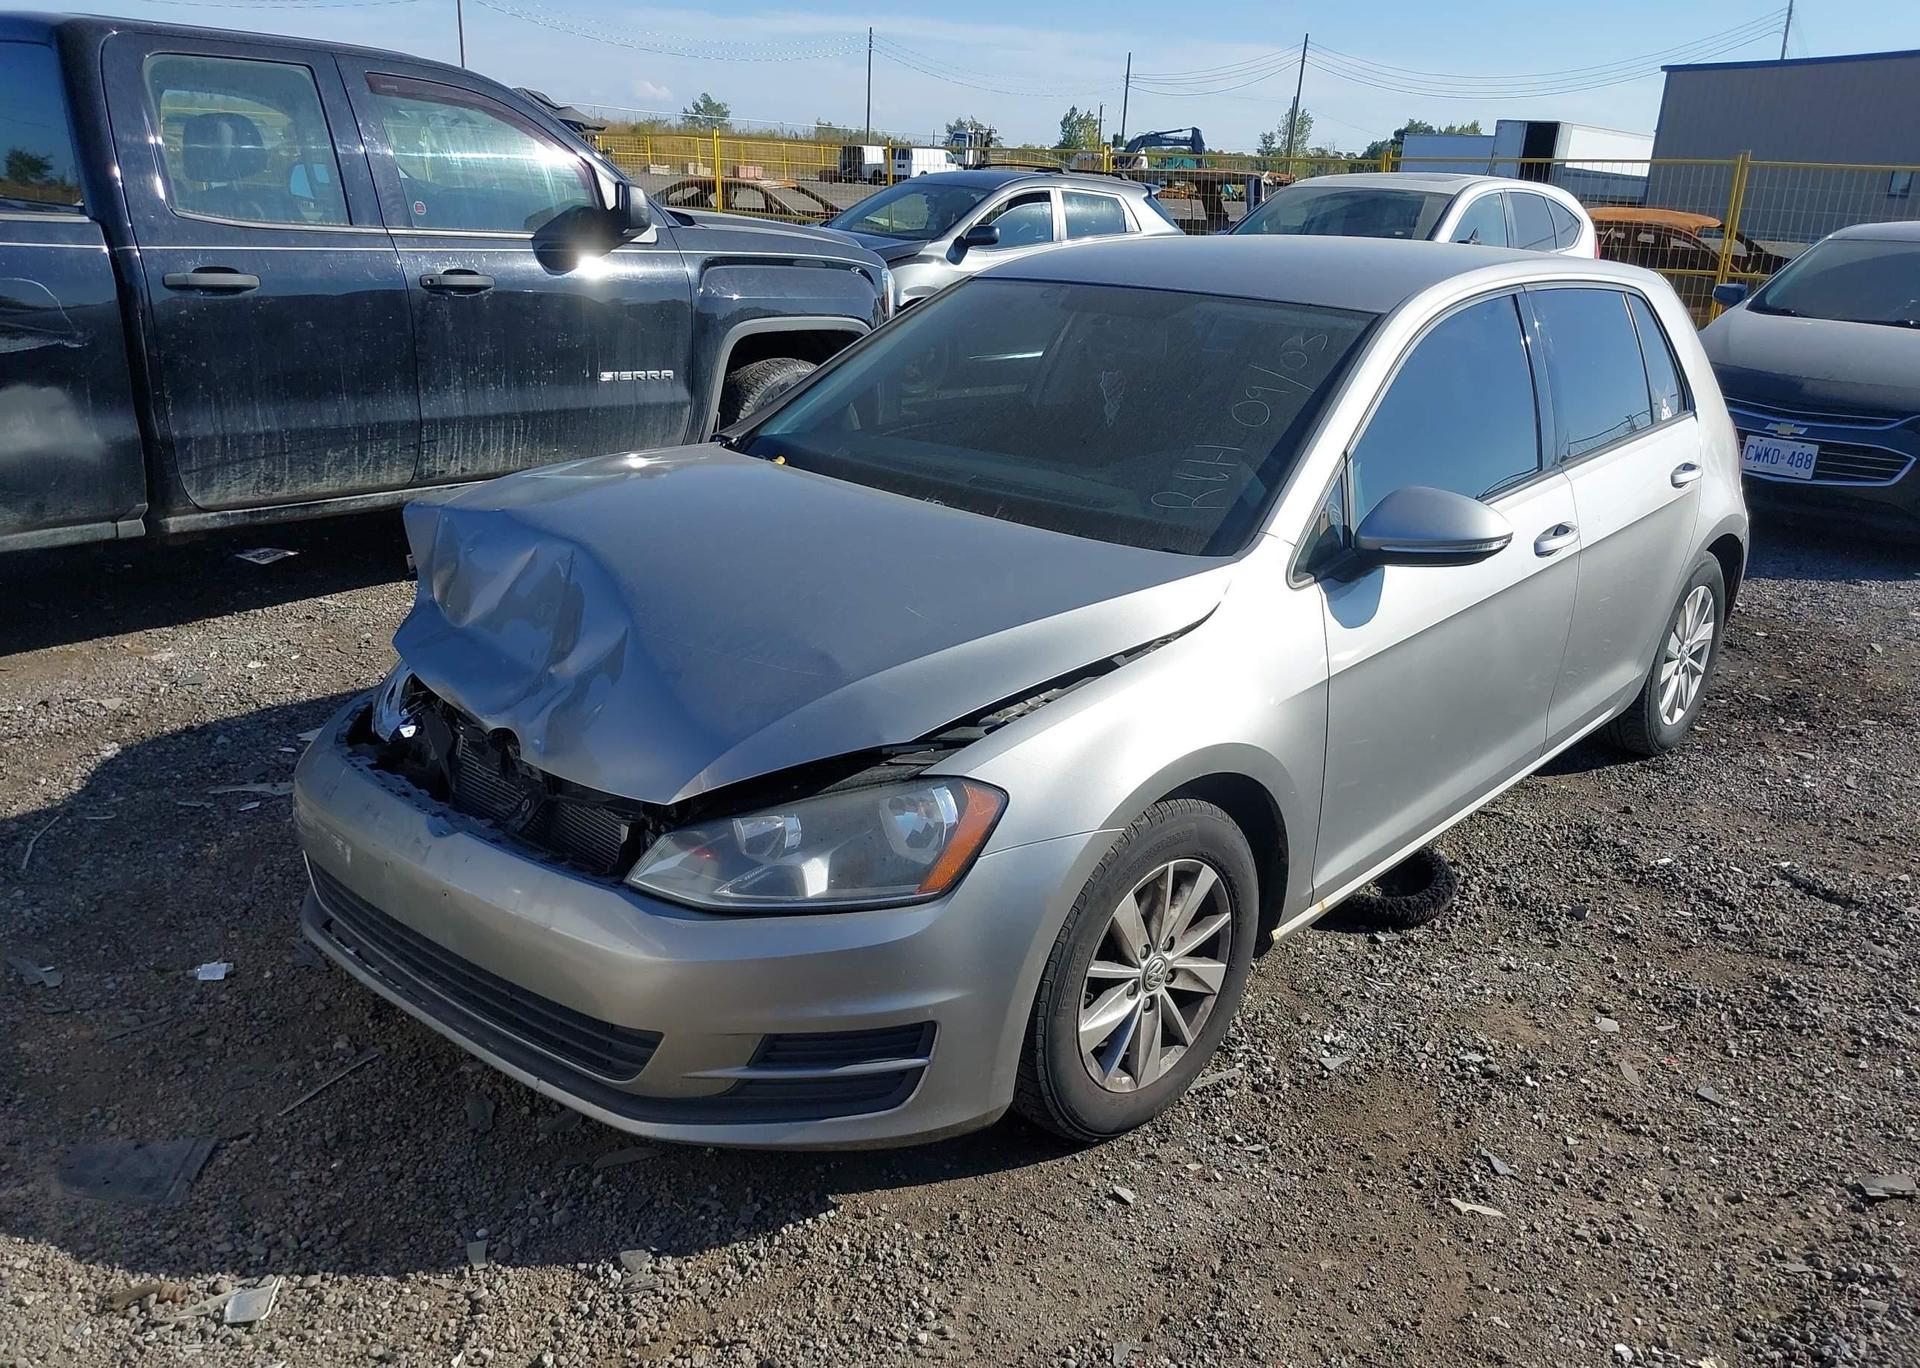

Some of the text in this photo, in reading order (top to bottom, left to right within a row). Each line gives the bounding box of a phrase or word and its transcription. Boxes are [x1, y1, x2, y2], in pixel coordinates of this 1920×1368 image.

[600, 370, 674, 381] SIERRA
[1744, 444, 1781, 465] CWKD
[1786, 450, 1814, 470] 488
